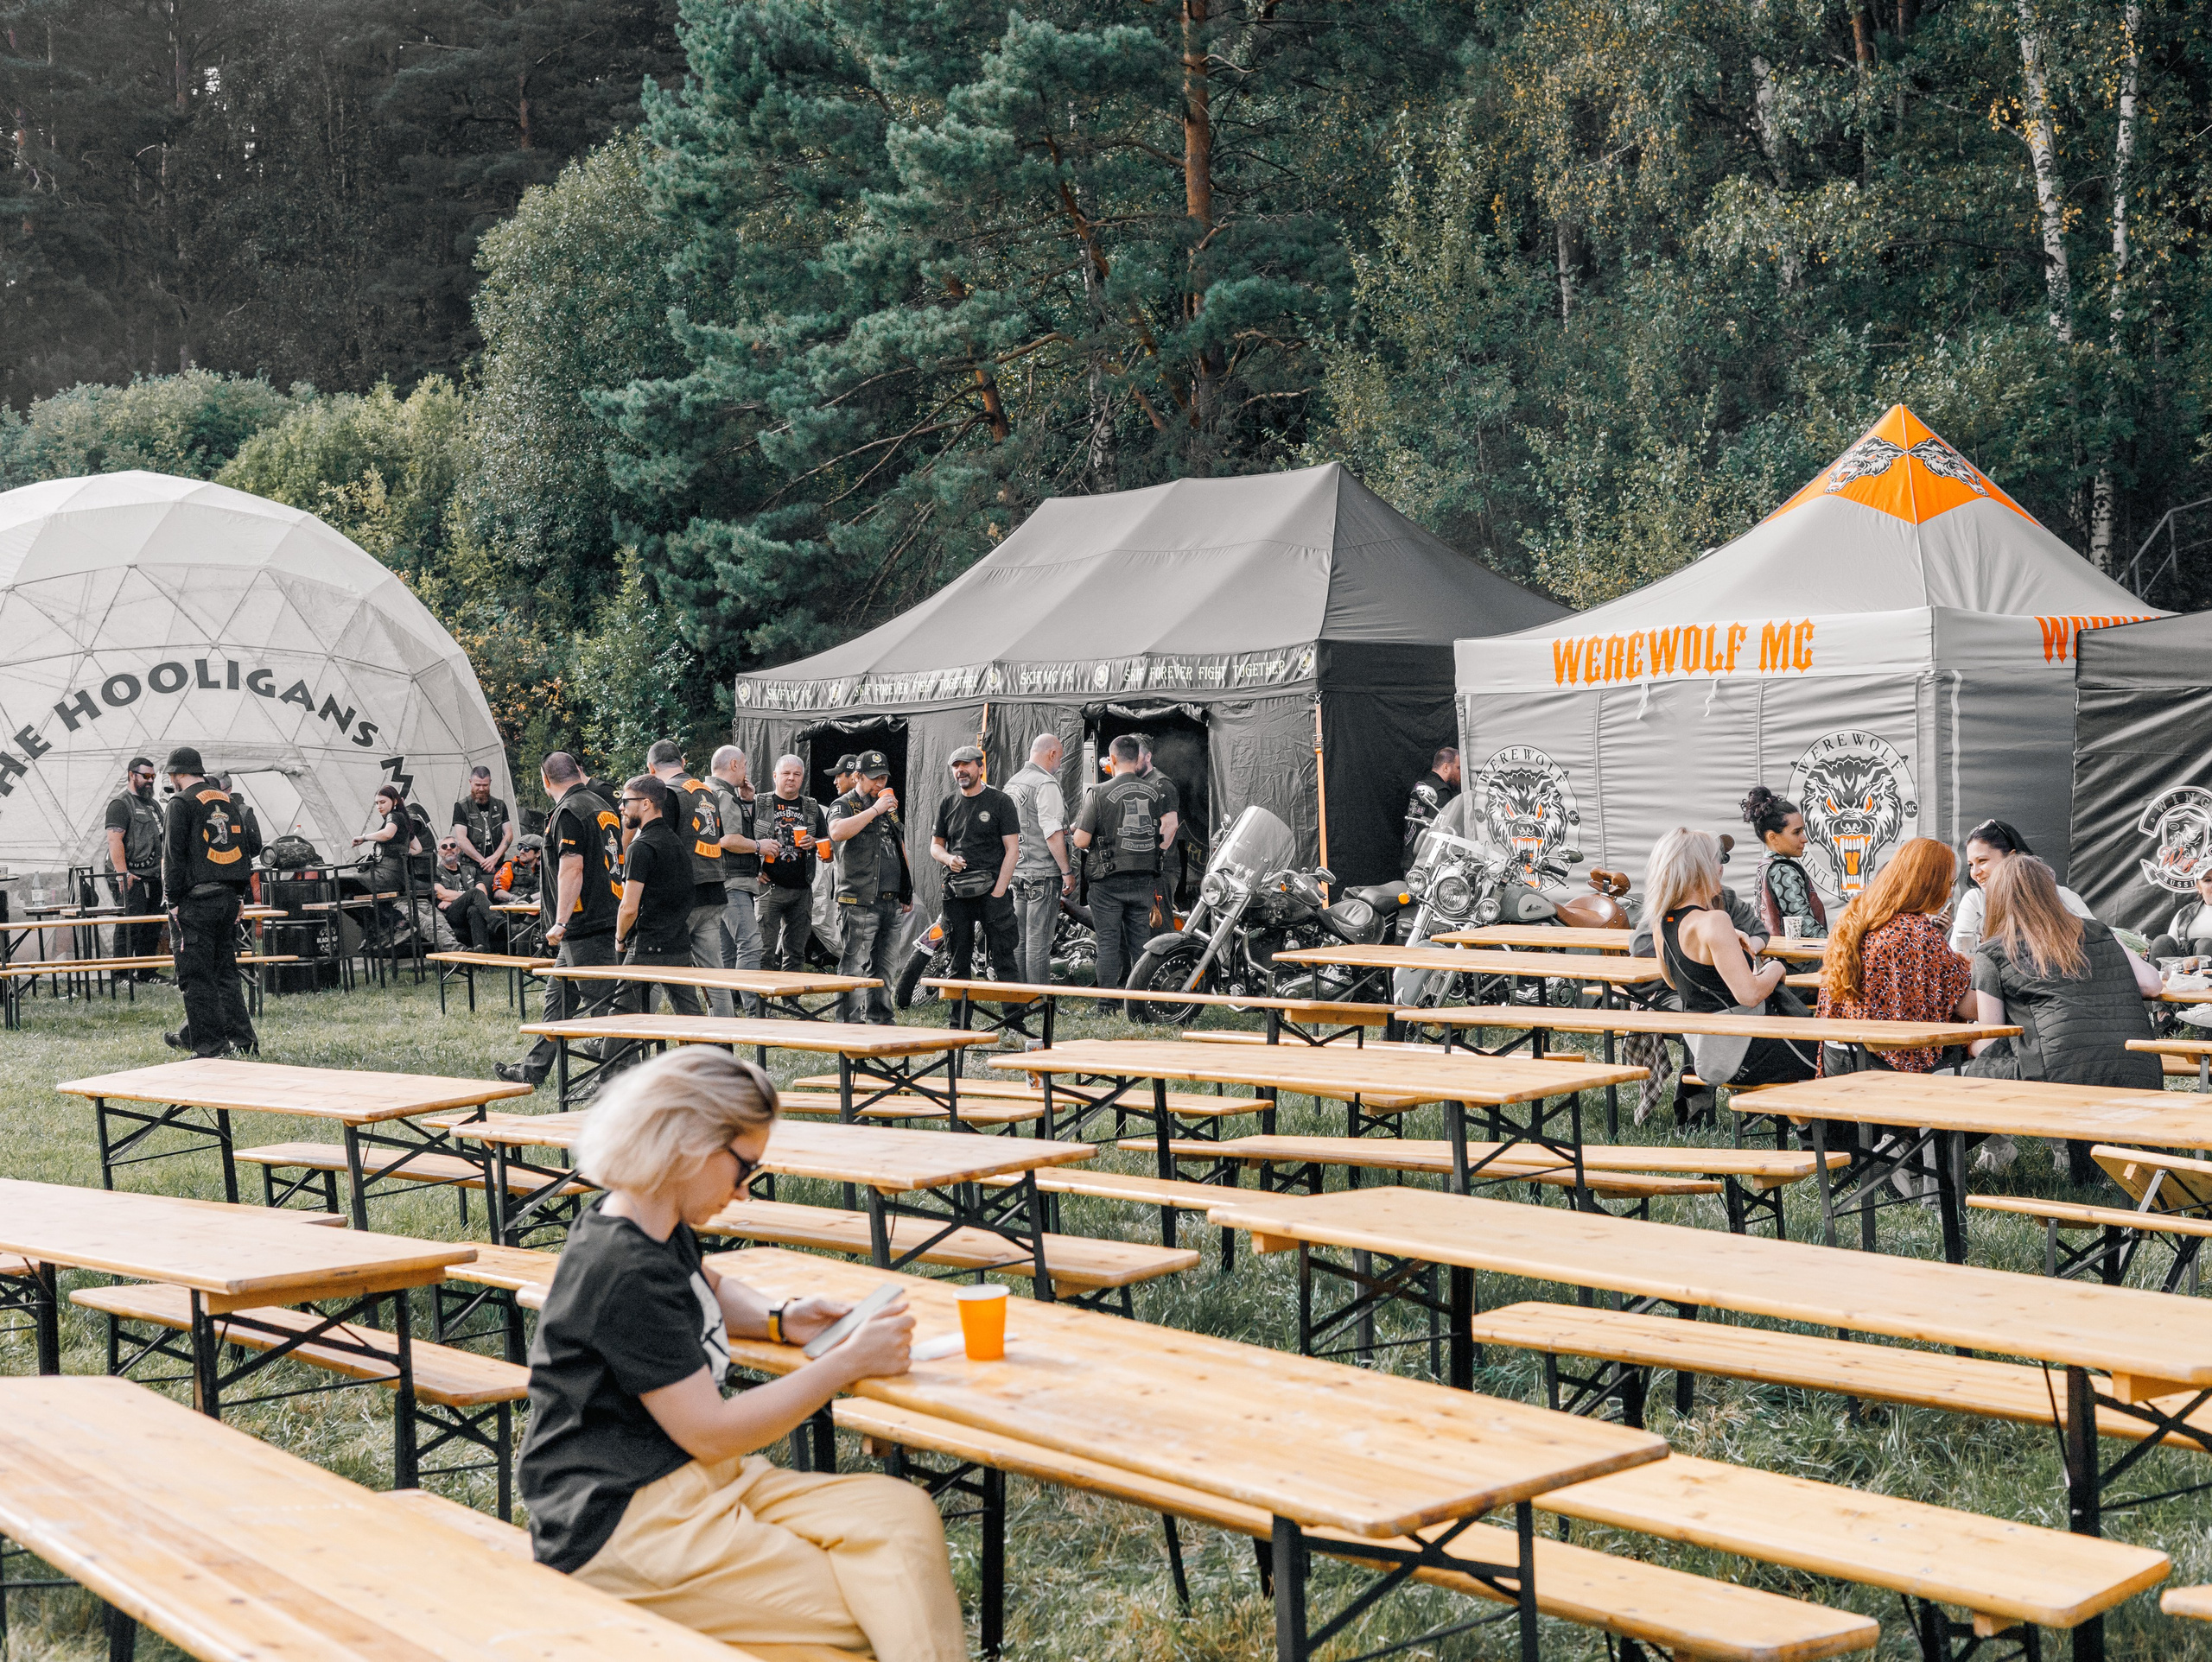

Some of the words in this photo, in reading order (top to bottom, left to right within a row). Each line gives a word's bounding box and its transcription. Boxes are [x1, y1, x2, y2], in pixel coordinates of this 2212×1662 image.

[1553, 621, 1749, 689] WEREWOLF
[1758, 617, 1815, 675] MC
[1020, 671, 1042, 686] SKIF
[1043, 670, 1058, 684] MC
[1061, 669, 1074, 683] 1%
[1149, 665, 1192, 681] FOREVER
[1198, 665, 1227, 680] FIGHT
[1232, 660, 1285, 678] TOGETHER
[0, 724, 53, 797] HE
[54, 658, 379, 748] HOOLIGANS
[1479, 748, 1566, 783] WEREWOLF
[1797, 733, 1903, 775] WEREWOLF
[1905, 804, 1917, 813] MC
[1801, 851, 1830, 883] AINT
[2163, 875, 2195, 888] RUSSI
